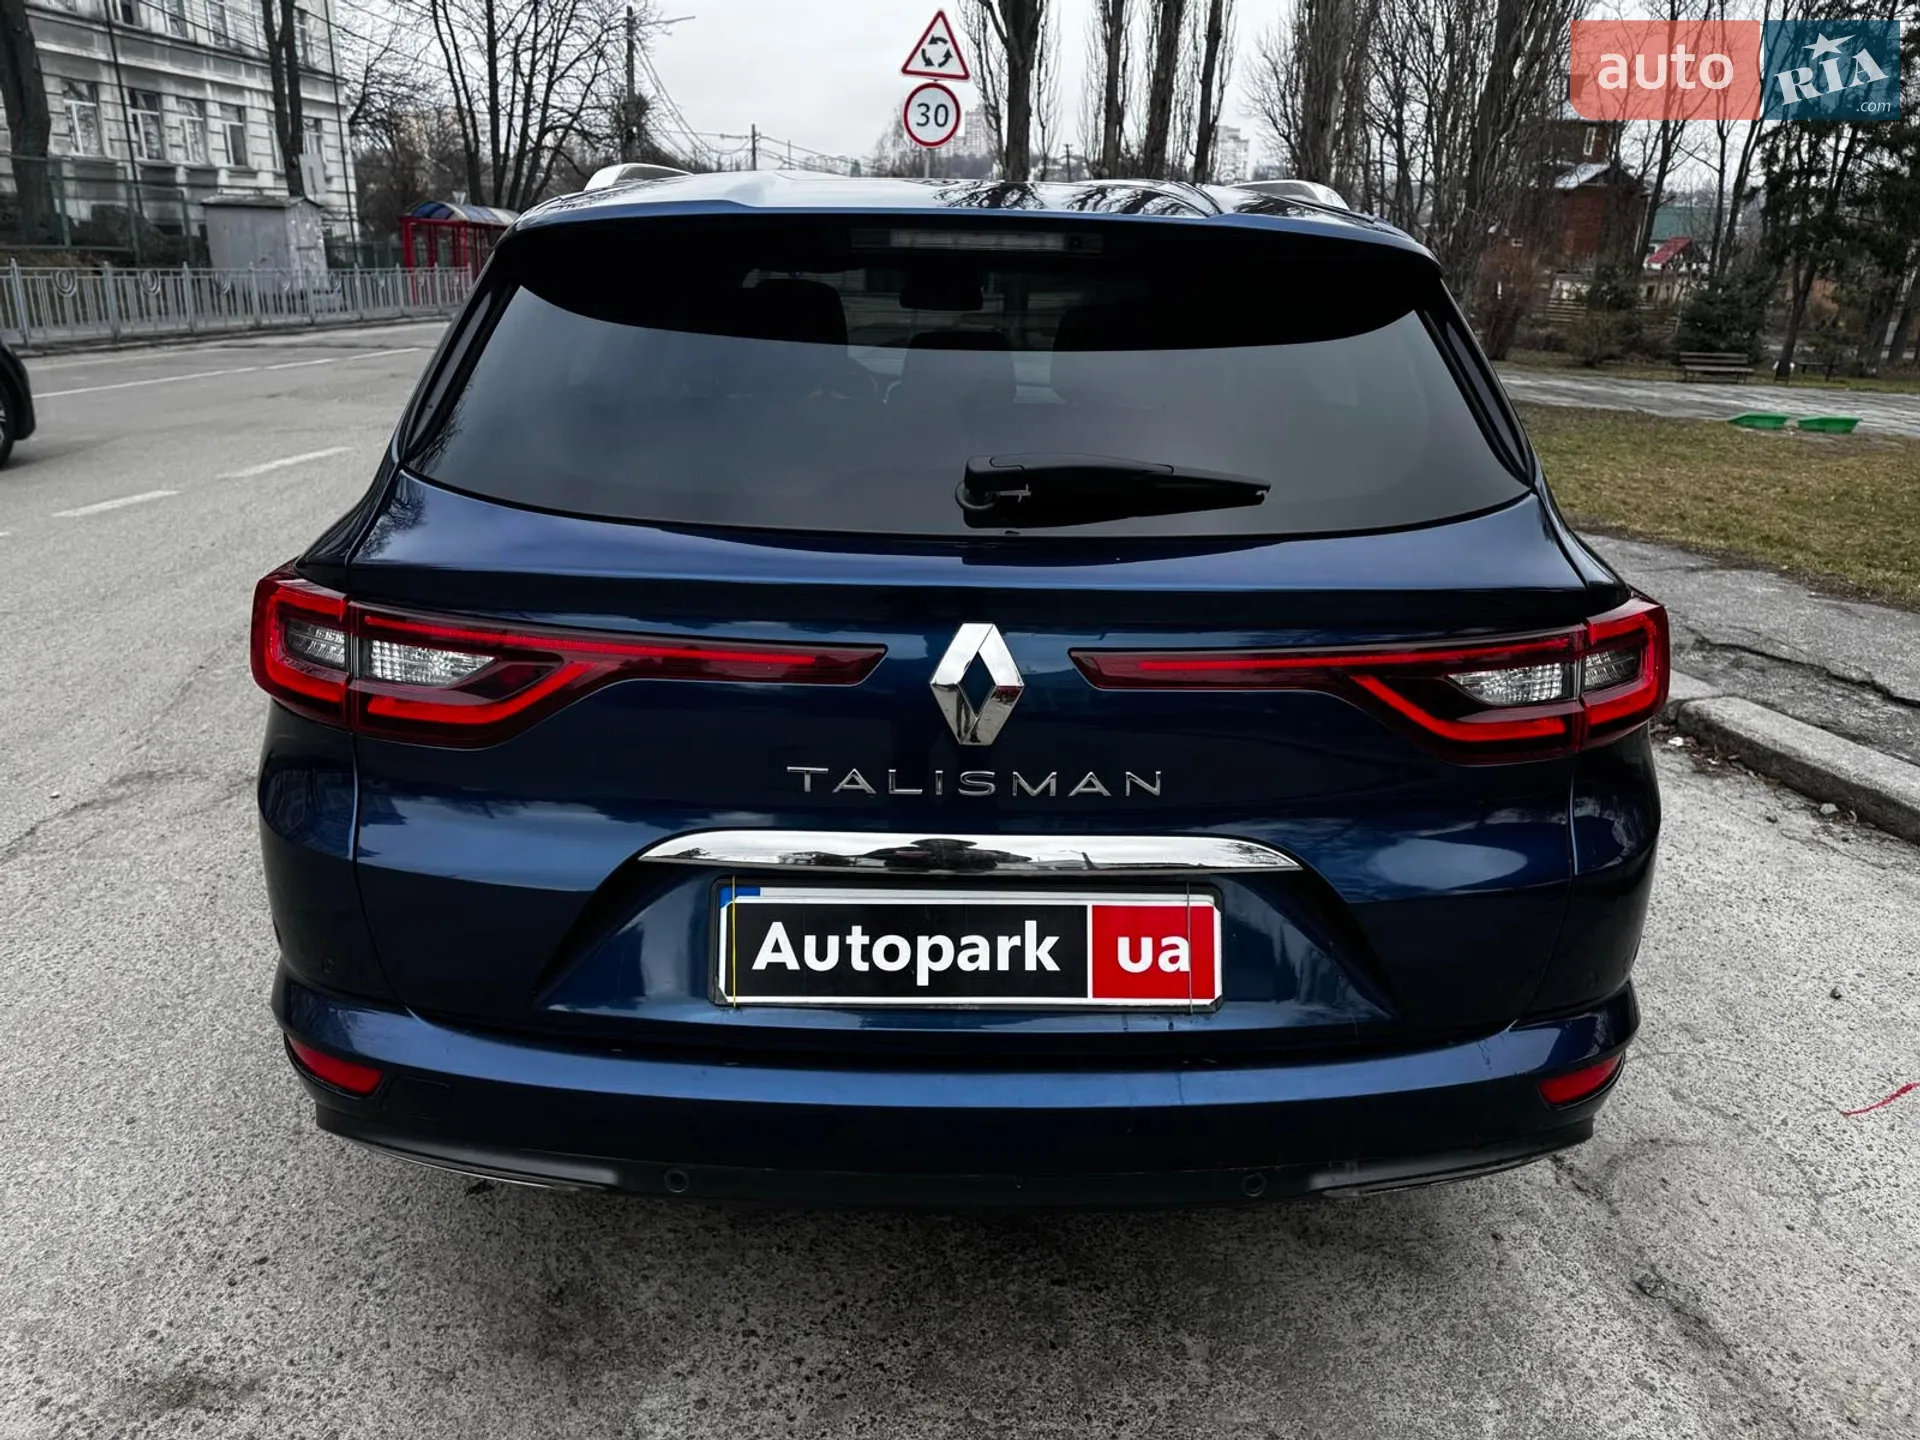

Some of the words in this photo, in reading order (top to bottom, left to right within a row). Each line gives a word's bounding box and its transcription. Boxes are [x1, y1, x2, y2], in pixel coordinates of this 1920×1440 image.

[916, 103, 949, 127] 30
[787, 766, 1163, 797] TALISMAN
[751, 920, 1060, 986] Autopark
[1117, 934, 1191, 973] ua
